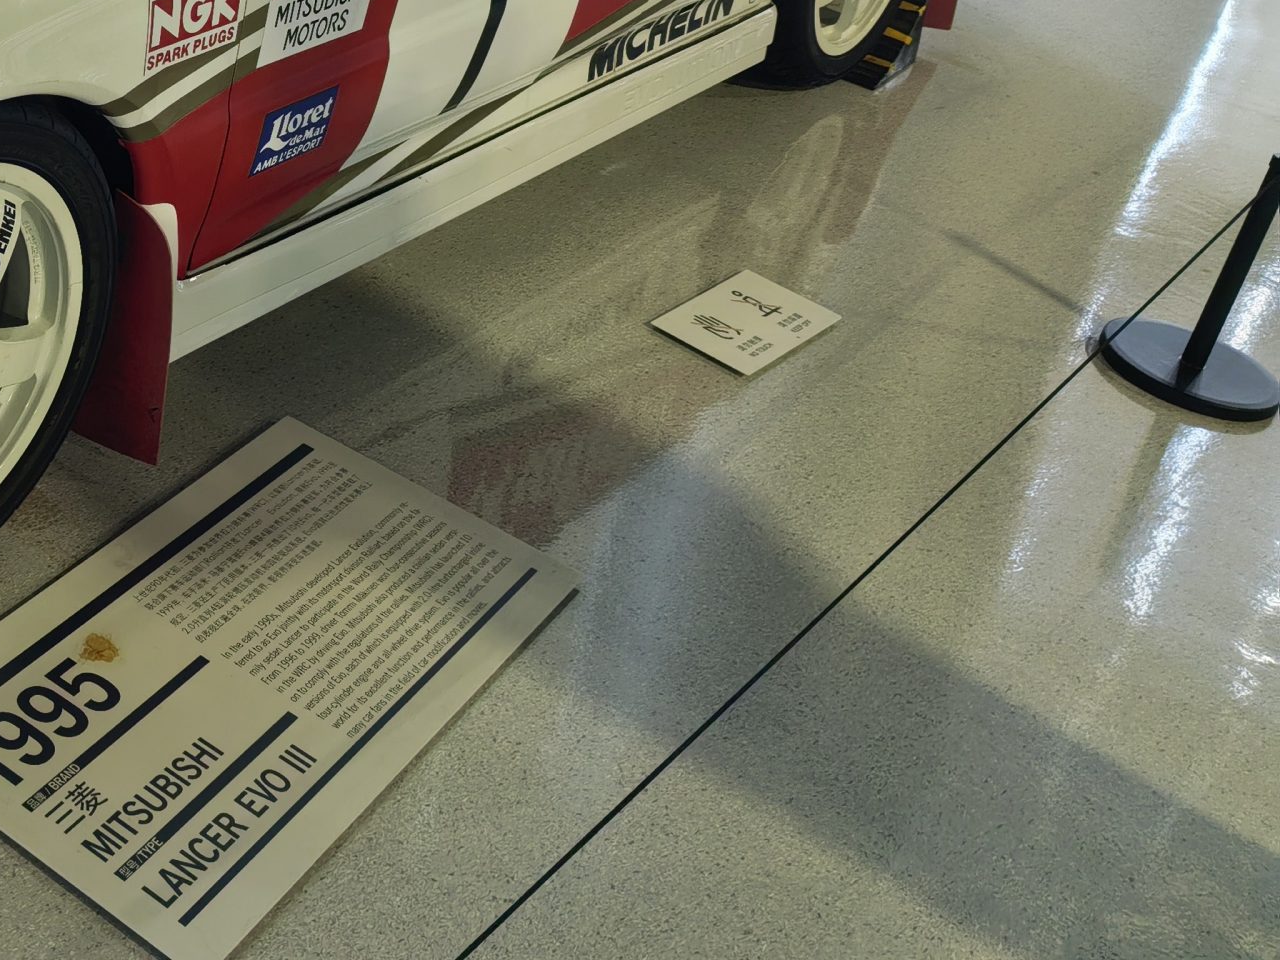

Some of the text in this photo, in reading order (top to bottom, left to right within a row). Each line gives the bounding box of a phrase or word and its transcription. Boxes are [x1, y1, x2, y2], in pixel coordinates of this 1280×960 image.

[282, 8, 350, 51] MOTORS
[146, 26, 235, 71] SPARK PLUGS
[260, 96, 333, 153] Lloret
[253, 136, 322, 174] AMB L'ESPORT
[220, 649, 233, 659] In
[227, 640, 244, 652] the
[238, 628, 260, 645] early
[274, 585, 308, 613] Mitsubishi
[250, 643, 263, 652] to
[259, 638, 271, 647] as
[265, 627, 282, 640] Evo
[293, 602, 311, 616] with
[259, 645, 283, 664] sedan
[277, 628, 303, 648] Lancer
[297, 622, 310, 631] to
[333, 591, 345, 600] in
[339, 583, 354, 594] the
[372, 614, 384, 623] of
[378, 606, 394, 617] the
[273, 684, 286, 693] in
[280, 674, 296, 687] the
[290, 661, 311, 677] WRC
[305, 654, 321, 665] by
[313, 637, 340, 658] driving
[344, 601, 377, 629] Mitsubishi
[334, 646, 350, 658] the
[361, 636, 383, 654] which
[377, 631, 389, 639] is
[259, 667, 281, 685] From
[276, 652, 298, 670] 1996
[292, 646, 305, 655] to
[322, 655, 340, 669] with
[342, 656, 362, 672] each
[349, 666, 376, 688] engine
[368, 655, 385, 669] and
[355, 650, 368, 659] of
[295, 685, 308, 694] to
[301, 666, 330, 690] comply
[323, 680, 336, 689] of
[329, 710, 351, 729] world
[345, 701, 360, 713] for
[354, 694, 368, 705] its
[361, 670, 392, 697] excellent
[386, 650, 414, 674] function
[407, 639, 424, 653] and
[289, 692, 301, 702] on
[301, 686, 330, 711] versions
[345, 720, 368, 739] many
[361, 711, 375, 722] car
[368, 697, 387, 713] fans
[380, 691, 394, 701] in
[387, 681, 403, 695] the
[408, 664, 421, 673] of
[25, 791, 48, 809] 品牌
[48, 763, 82, 790] BRAND
[80, 736, 225, 862] MITSUBISHI
[44, 780, 108, 835] 三菱
[140, 743, 318, 908] LANCER EVO III
[117, 858, 140, 878] 型号
